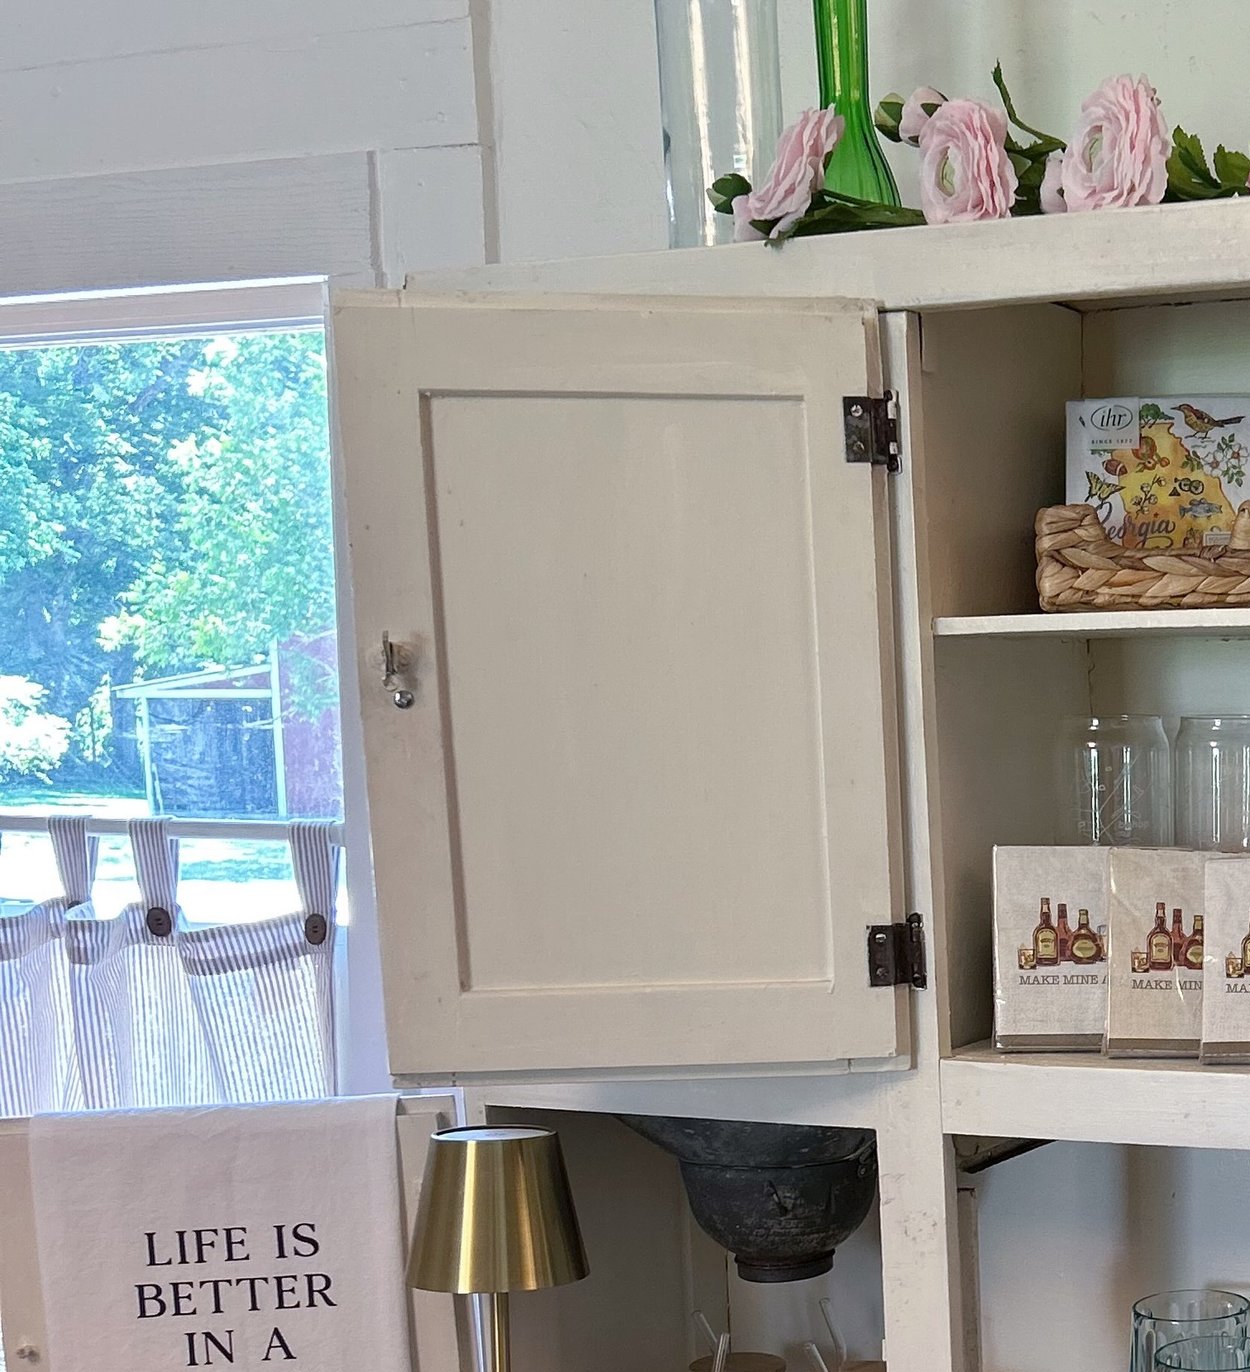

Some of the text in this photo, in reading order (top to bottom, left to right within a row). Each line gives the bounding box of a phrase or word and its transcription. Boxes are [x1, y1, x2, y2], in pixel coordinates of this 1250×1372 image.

[1019, 974, 1060, 985] MAKE
[1062, 974, 1099, 985] MINE
[1131, 979, 1203, 991] MAKE MIN
[144, 1222, 320, 1267] LIFE IS
[134, 1273, 338, 1319] BETTER
[184, 1326, 297, 1367] IN A
